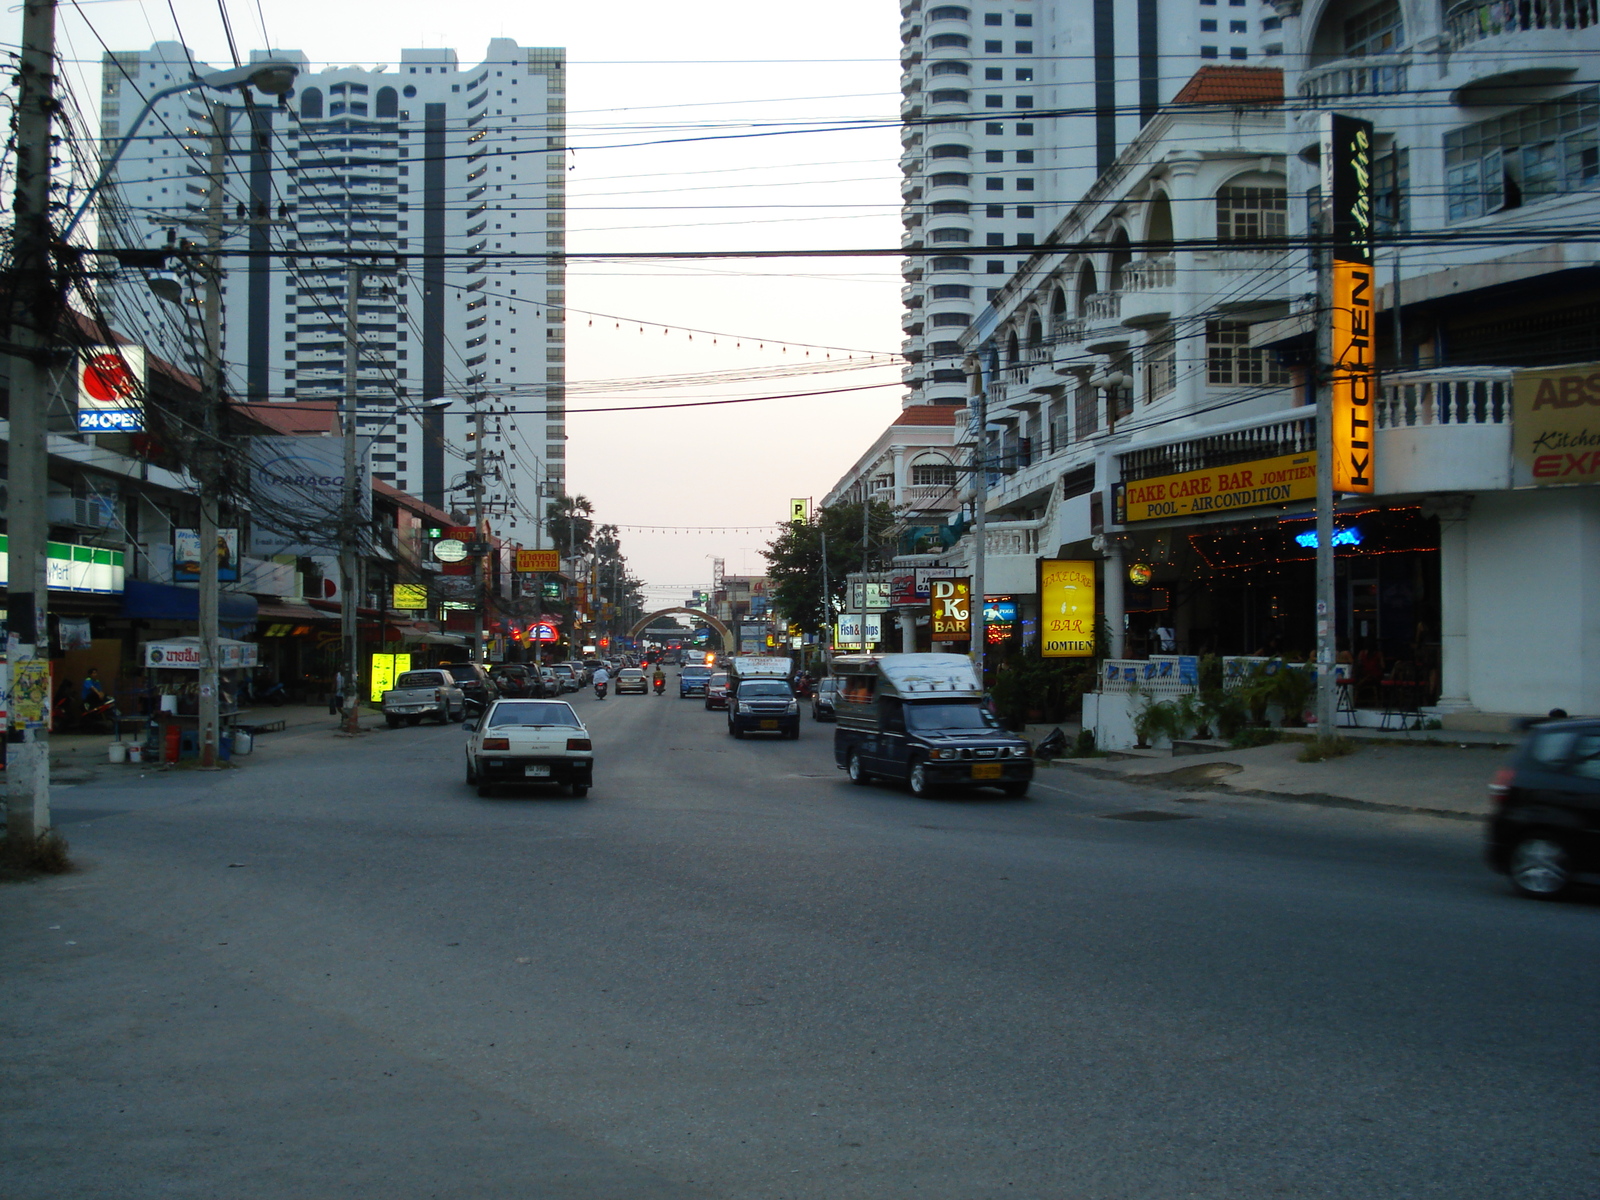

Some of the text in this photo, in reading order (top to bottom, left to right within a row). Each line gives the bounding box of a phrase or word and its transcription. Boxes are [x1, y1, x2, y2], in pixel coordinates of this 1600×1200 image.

[1351, 272, 1370, 485] KITCHEN
[80, 413, 142, 428] 24 OPEN
[1128, 484, 1166, 504] TAKE
[1169, 477, 1211, 499] CARE
[1218, 470, 1253, 492] BAR
[1260, 464, 1316, 485] JOMTIEN
[1147, 502, 1178, 517] POOL
[1043, 571, 1092, 588] TAKE CARE
[841, 624, 879, 637] Fish & hips
[934, 621, 966, 633] BAR
[1050, 619, 1085, 634] BAR
[1045, 640, 1093, 651] JOMTIEN
